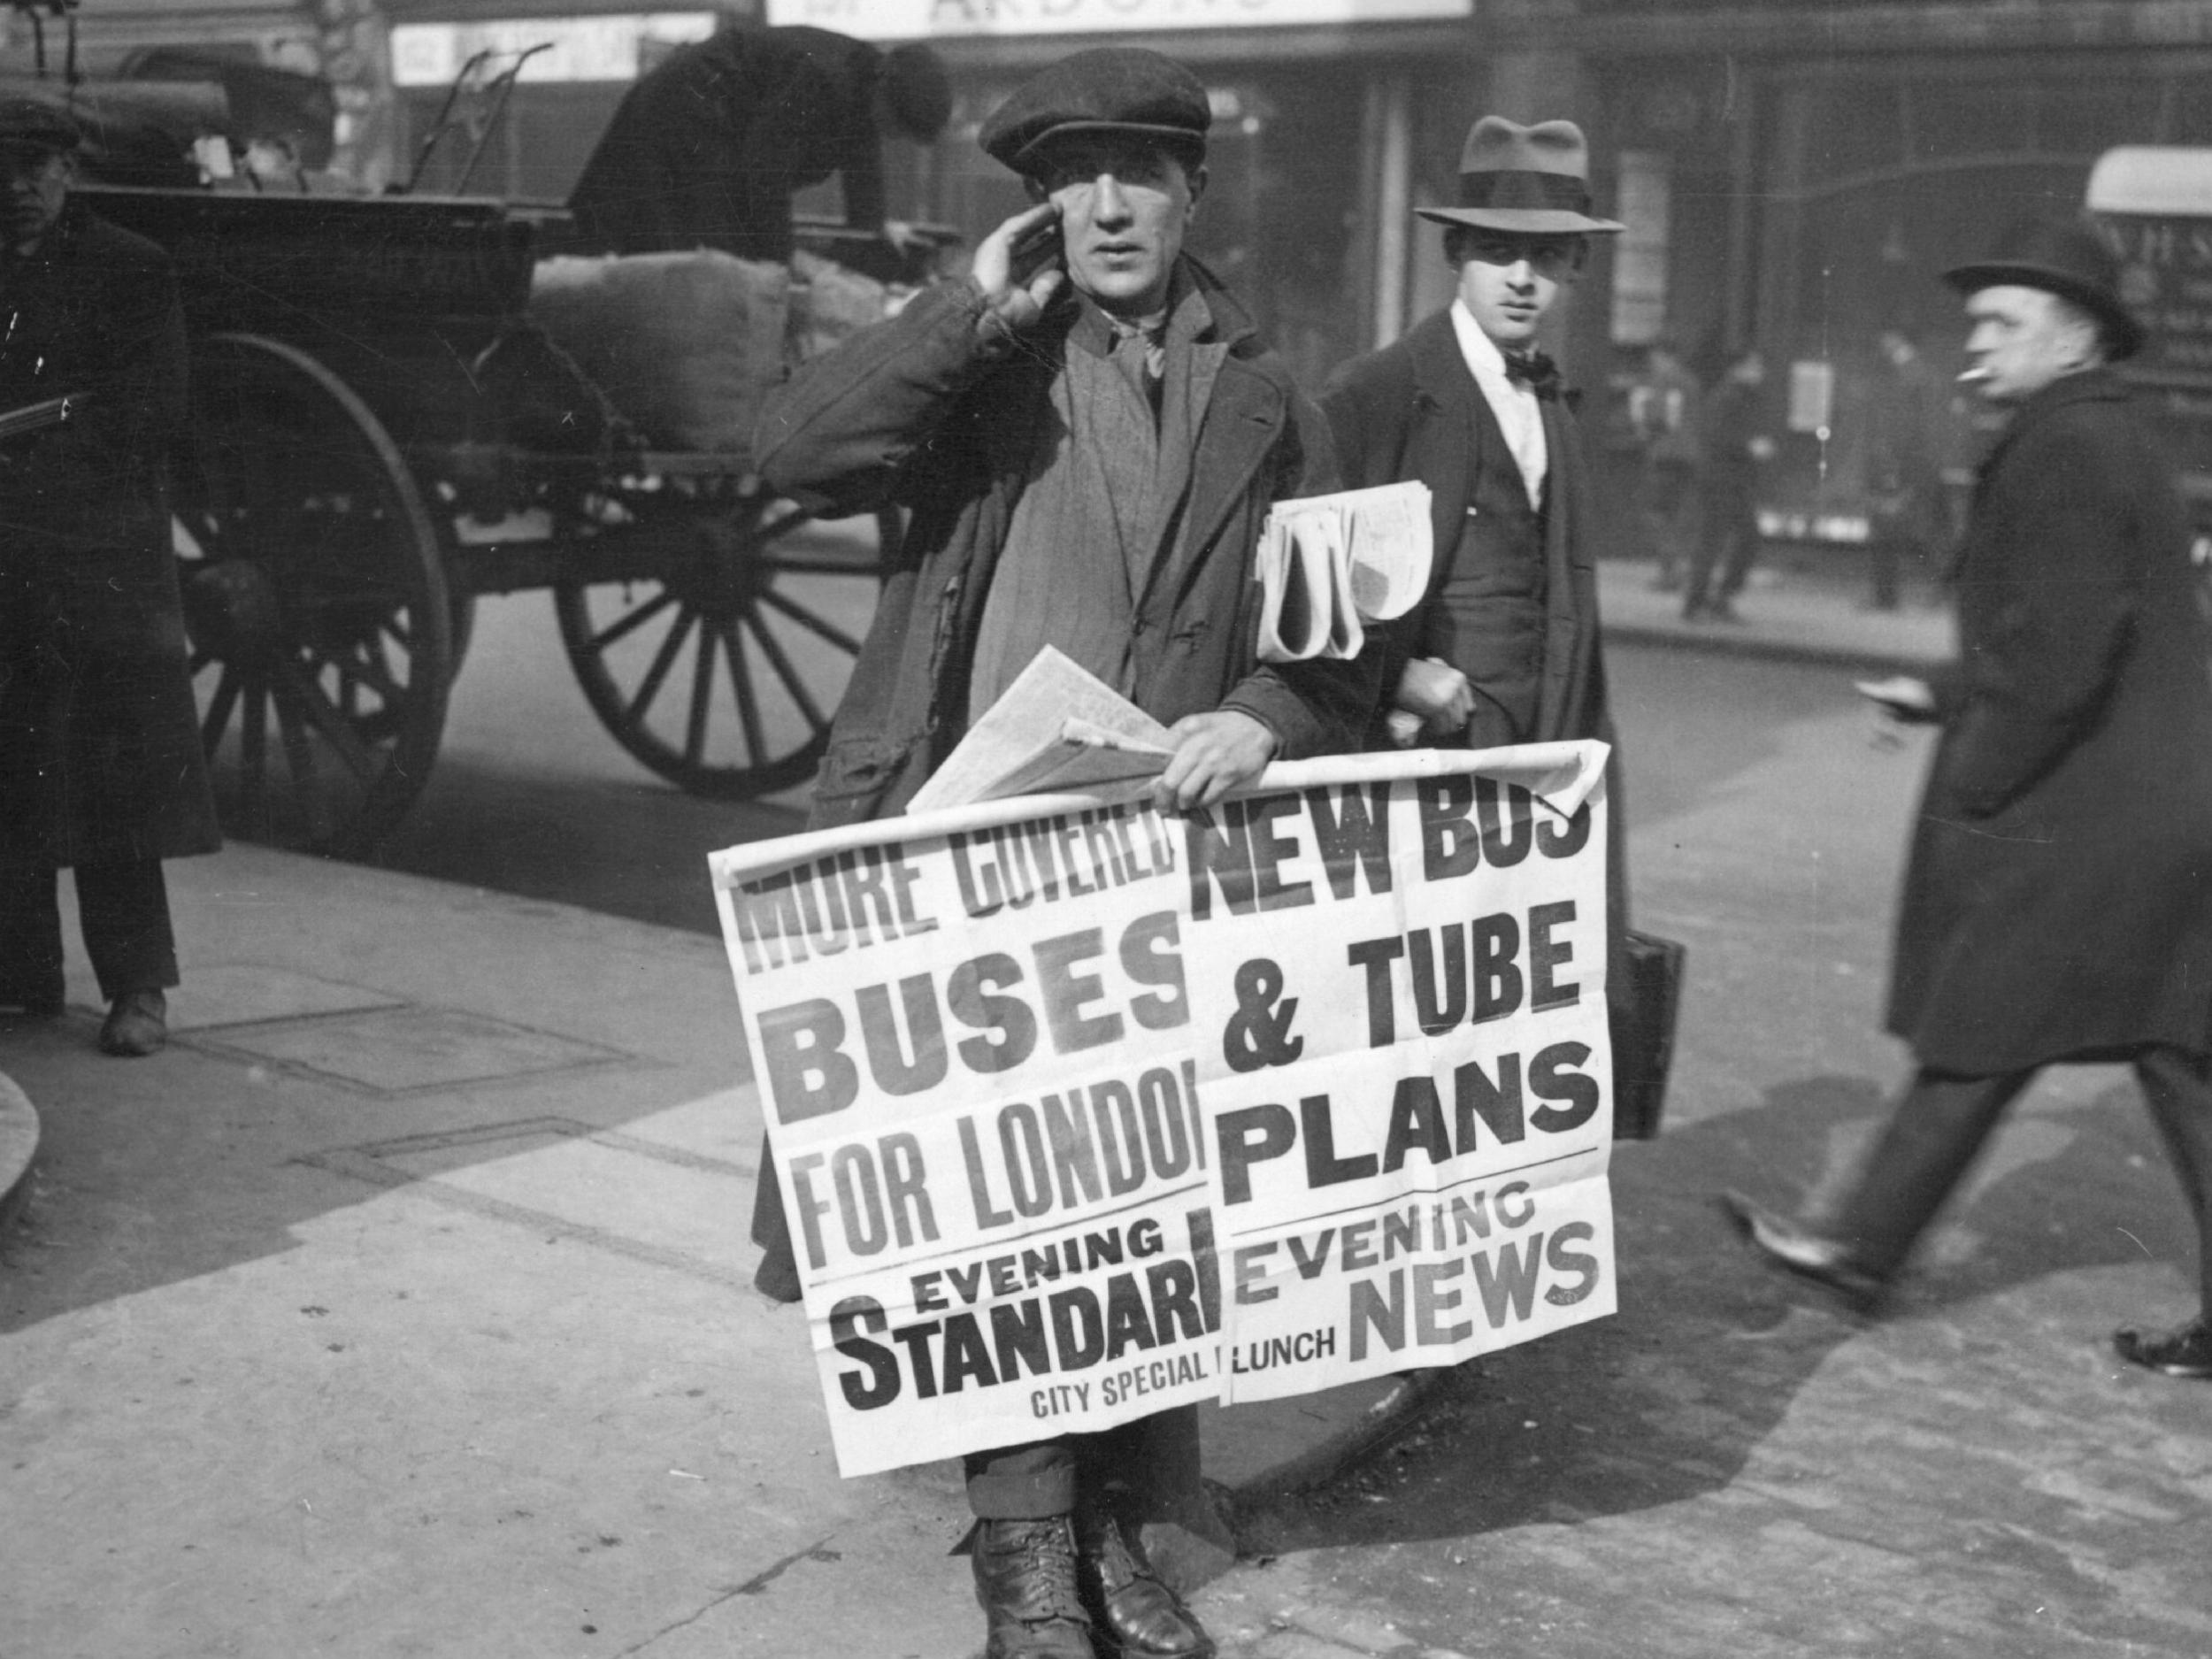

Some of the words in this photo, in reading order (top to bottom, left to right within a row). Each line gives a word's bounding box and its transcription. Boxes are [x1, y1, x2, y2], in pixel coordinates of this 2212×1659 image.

[728, 841, 939, 975] MORE
[948, 798, 1176, 918] COVERED
[1179, 780, 1394, 922] NEW
[1417, 773, 1591, 882] BUS
[757, 910, 1190, 1125] BUSES
[1223, 957, 1303, 1073] &
[1347, 900, 1580, 1048] TUBE
[1214, 1041, 1600, 1206] PLANS
[789, 1132, 941, 1271] FOR
[910, 1217, 1164, 1314] EVENING
[1233, 1180, 1535, 1306] EVENING
[1232, 1326, 1336, 1374] LUNCH
[1349, 1220, 1600, 1363] NEWS
[1030, 1383, 1091, 1419] CITY
[1102, 1351, 1209, 1407] SPECIAL
